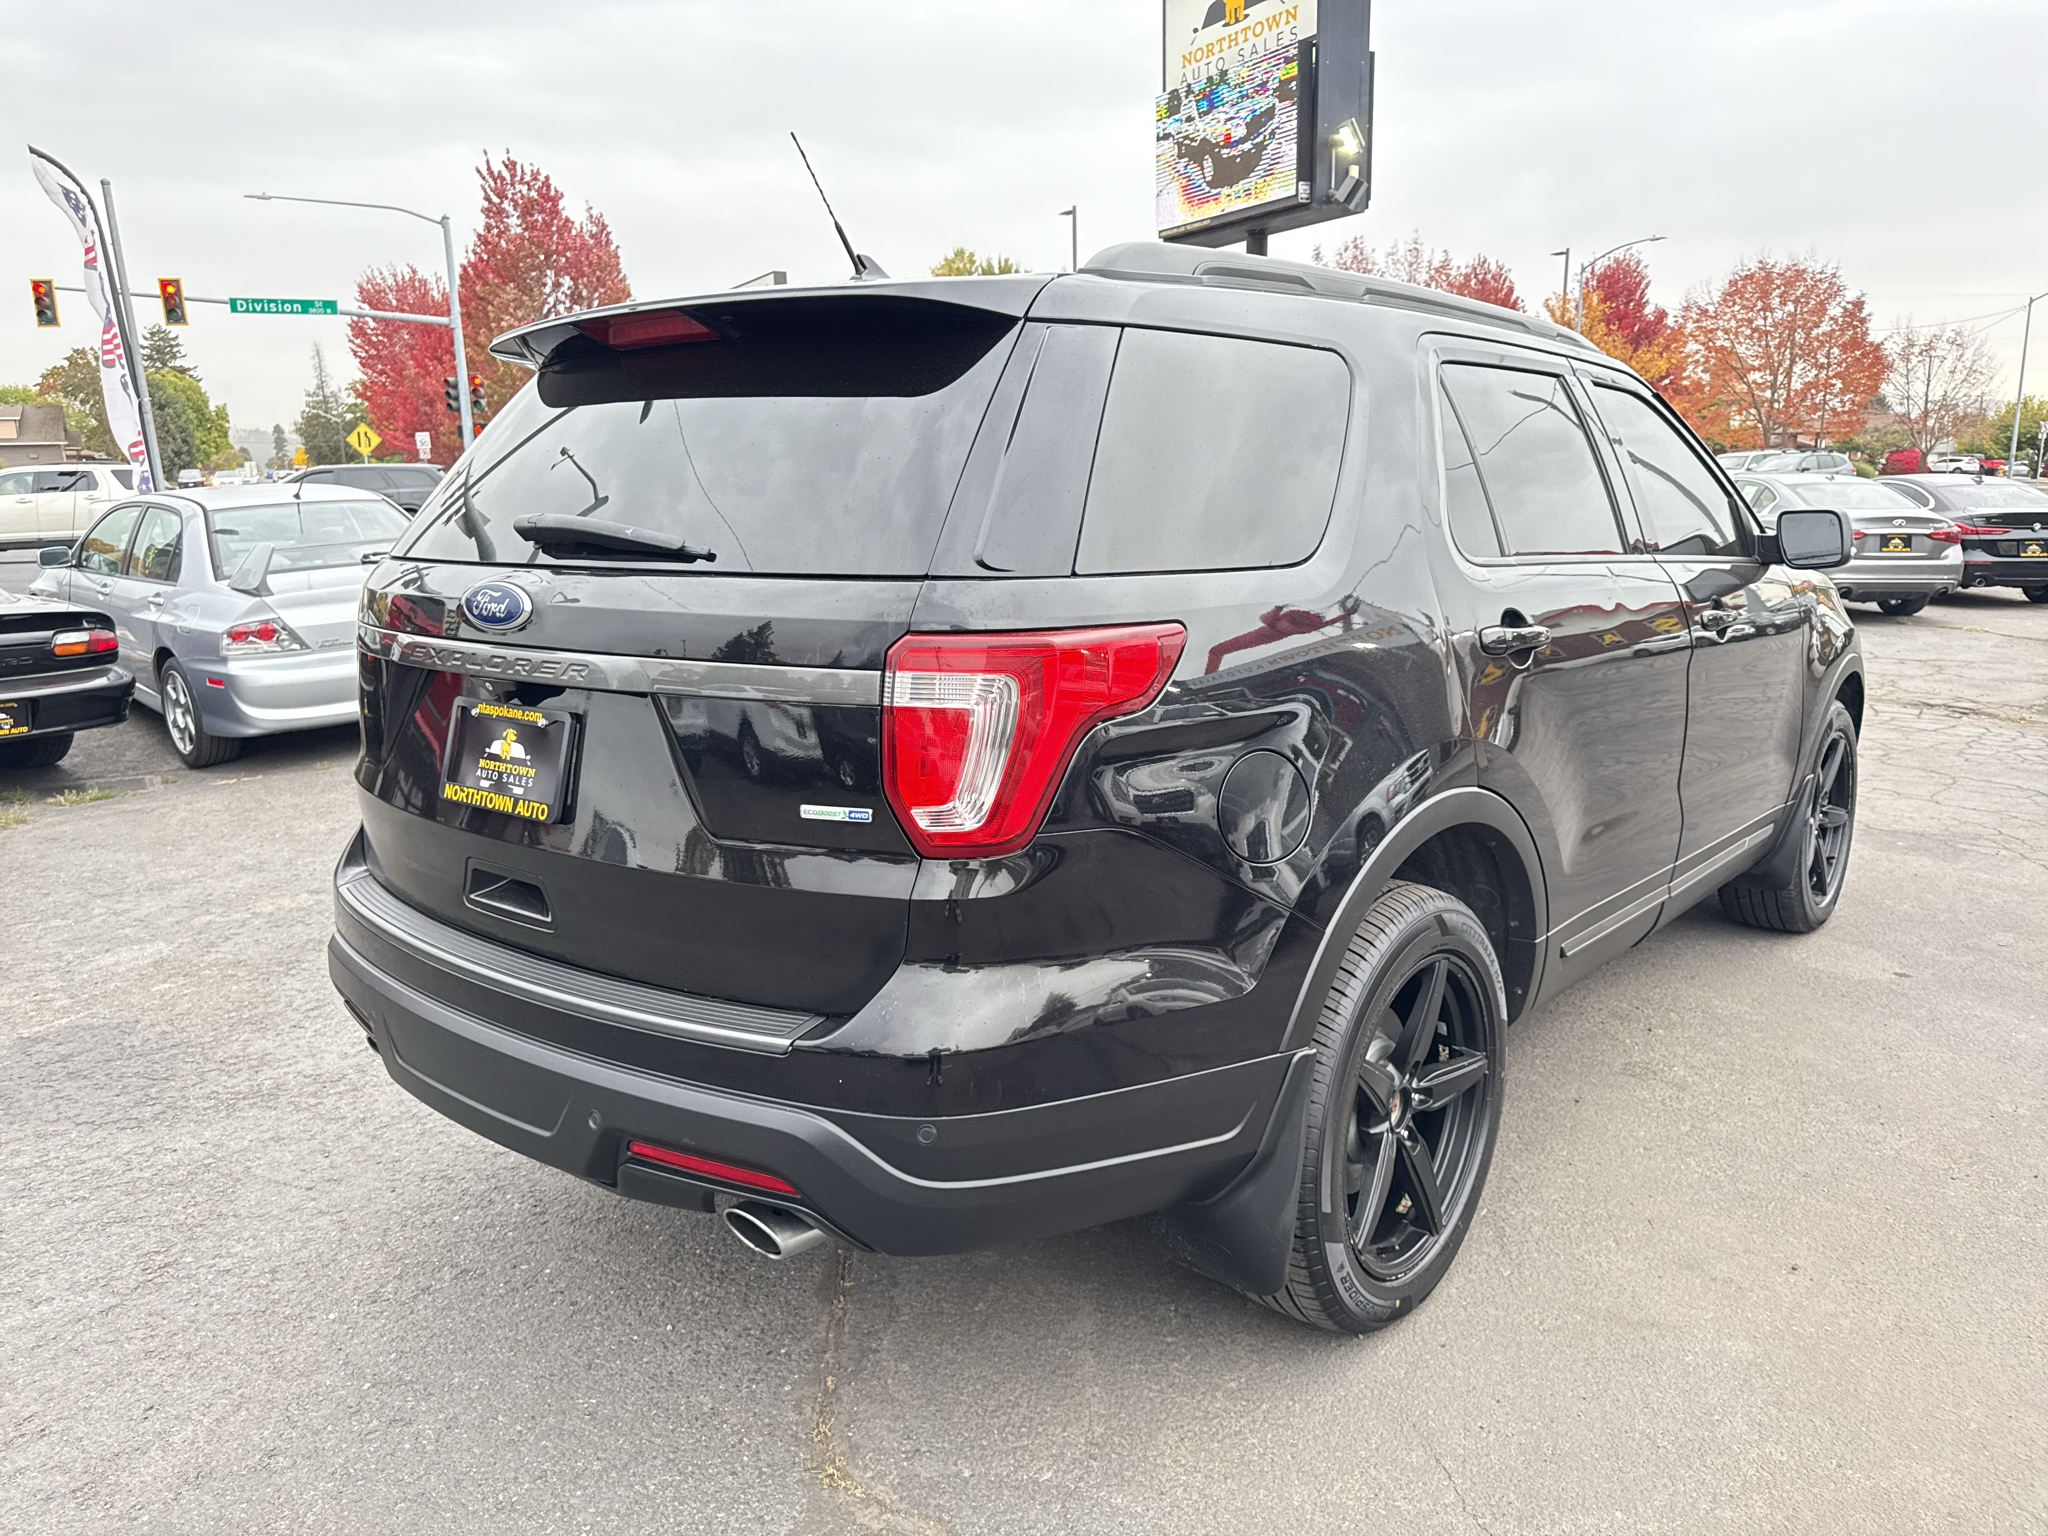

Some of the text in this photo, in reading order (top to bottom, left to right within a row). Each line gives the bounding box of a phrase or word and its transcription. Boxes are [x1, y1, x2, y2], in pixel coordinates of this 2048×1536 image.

[1181, 5, 1299, 69] NORTHTOWN
[1180, 26, 1299, 86] AUTO SALES
[236, 299, 302, 313] Division
[472, 589, 510, 618] Ford
[409, 645, 590, 682] EXPLORER
[477, 702, 543, 723] ntaspokane.com
[475, 768, 534, 788] AUTO SALES
[478, 758, 537, 778] NORTHTOWN
[443, 783, 549, 821] NORTHTOWN AUTO
[803, 808, 869, 820] ECOBOOST 4WD
